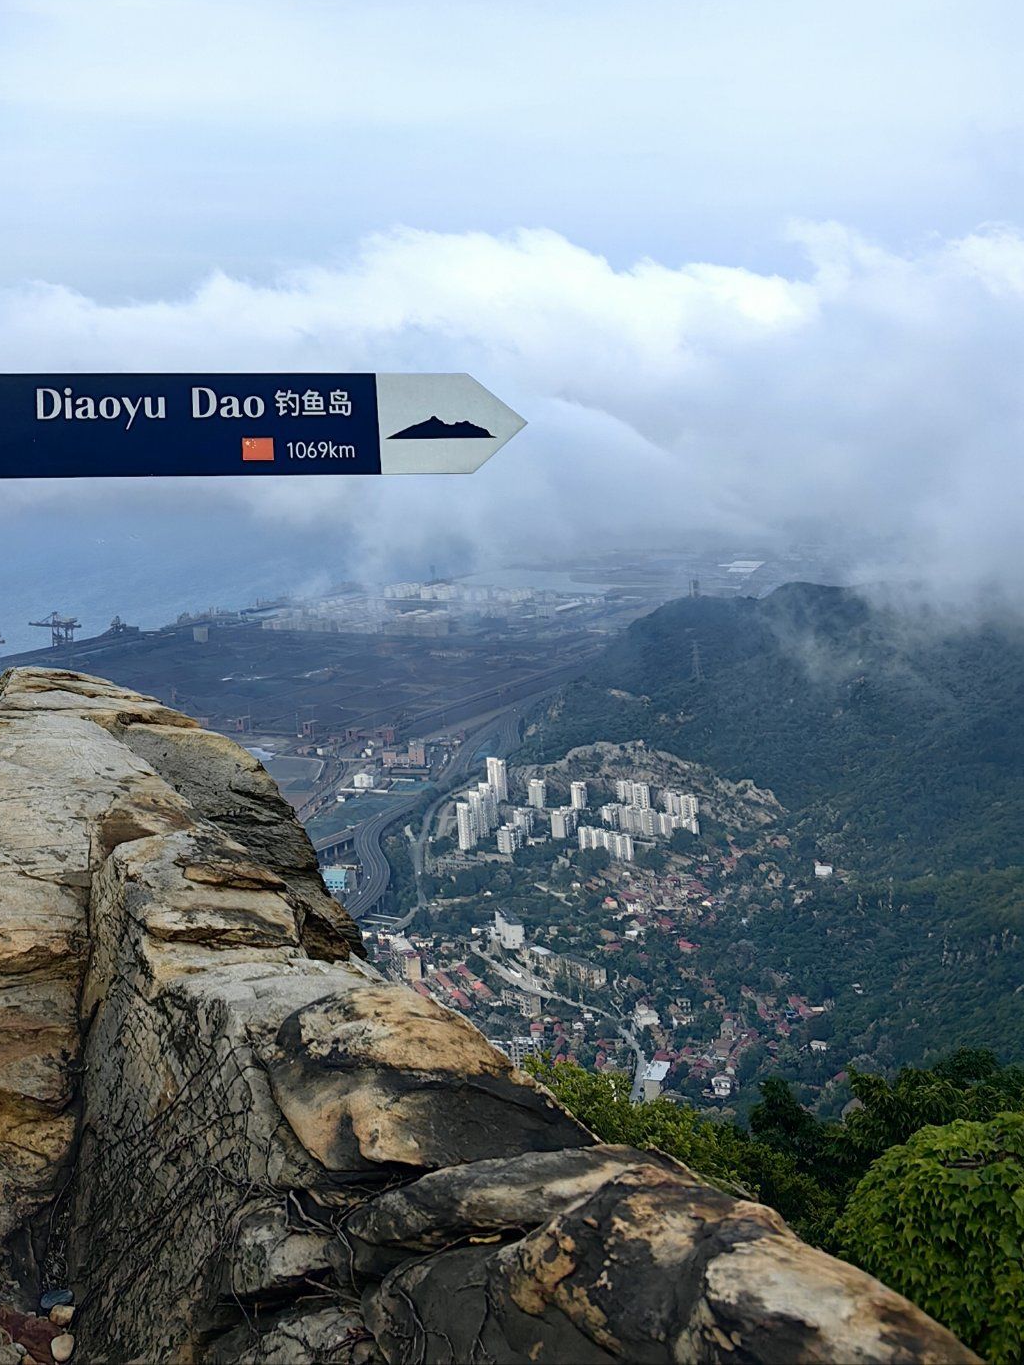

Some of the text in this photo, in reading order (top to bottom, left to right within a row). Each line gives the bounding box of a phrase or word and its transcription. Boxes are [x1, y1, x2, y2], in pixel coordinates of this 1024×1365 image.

[36, 387, 352, 430] Diaoyu Dao 钓鱼岛
[286, 441, 355, 459] 1069km
